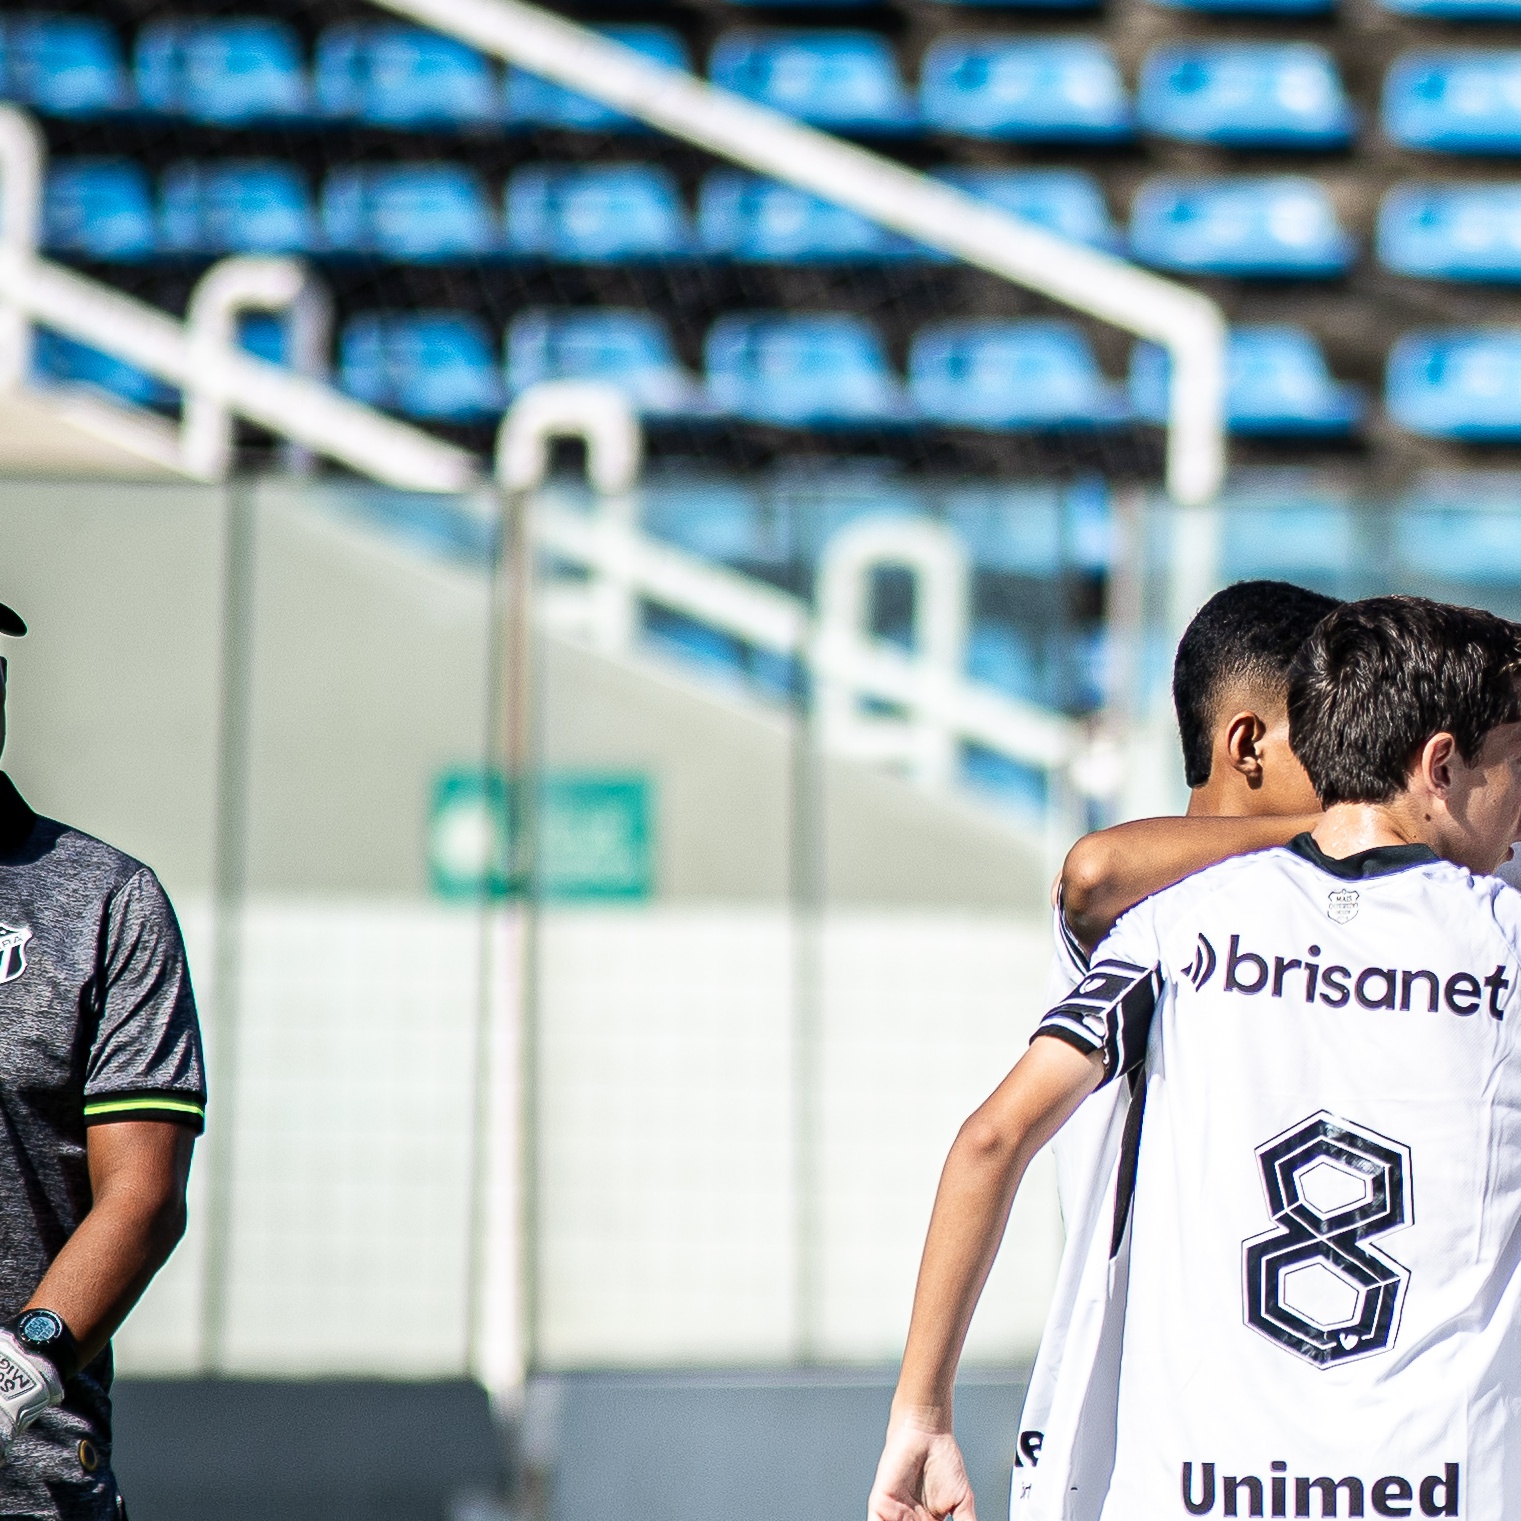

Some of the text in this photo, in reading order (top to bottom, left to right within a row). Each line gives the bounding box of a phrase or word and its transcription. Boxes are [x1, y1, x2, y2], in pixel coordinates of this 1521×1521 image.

[1224, 934, 1509, 1021] brisanet
[1241, 1109, 1415, 1370] 8
[1180, 1460, 1459, 1518] Unimed
